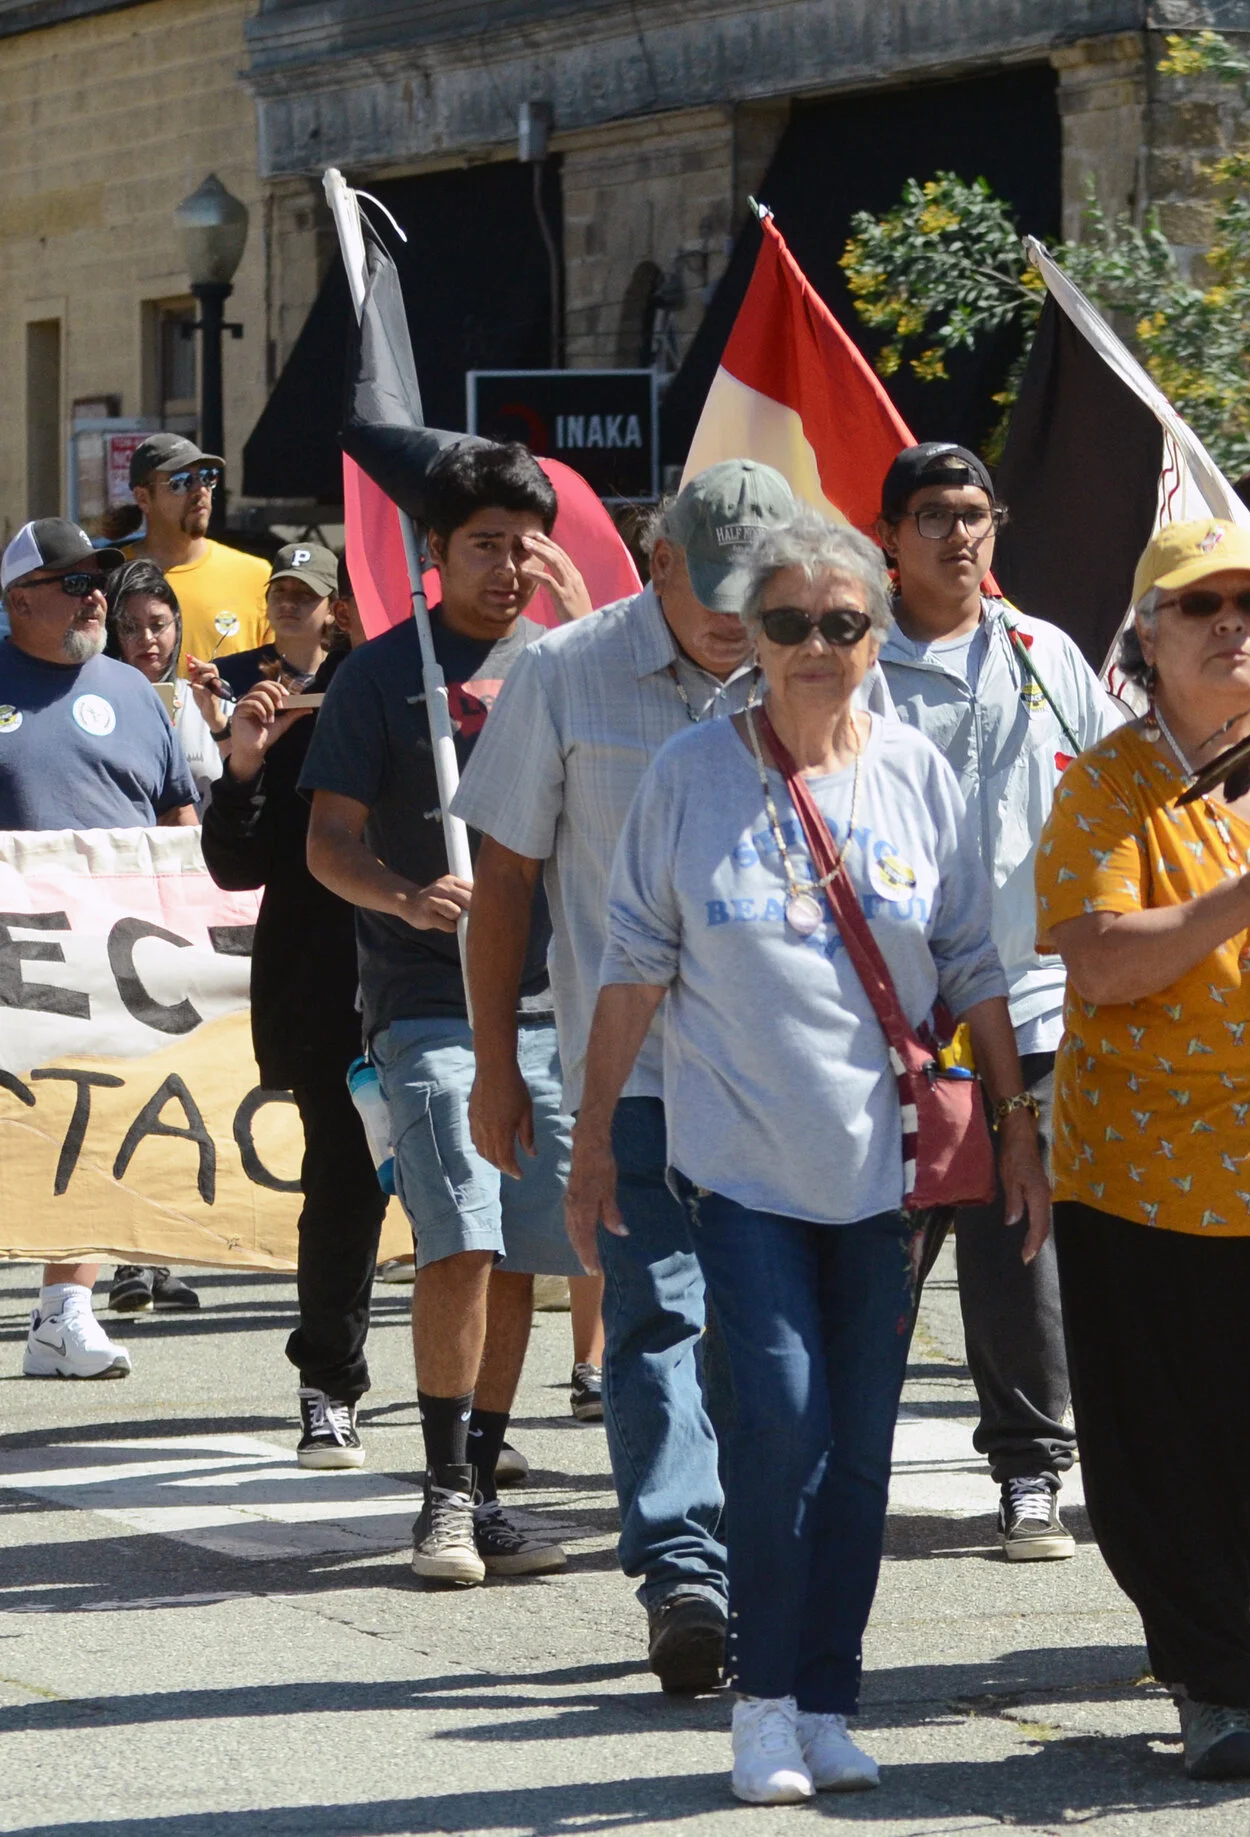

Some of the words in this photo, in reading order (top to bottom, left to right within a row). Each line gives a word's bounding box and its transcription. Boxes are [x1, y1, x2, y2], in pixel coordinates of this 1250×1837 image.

[556, 414, 642, 449] INAKA
[715, 526, 742, 545] HALF
[291, 549, 311, 567] P
